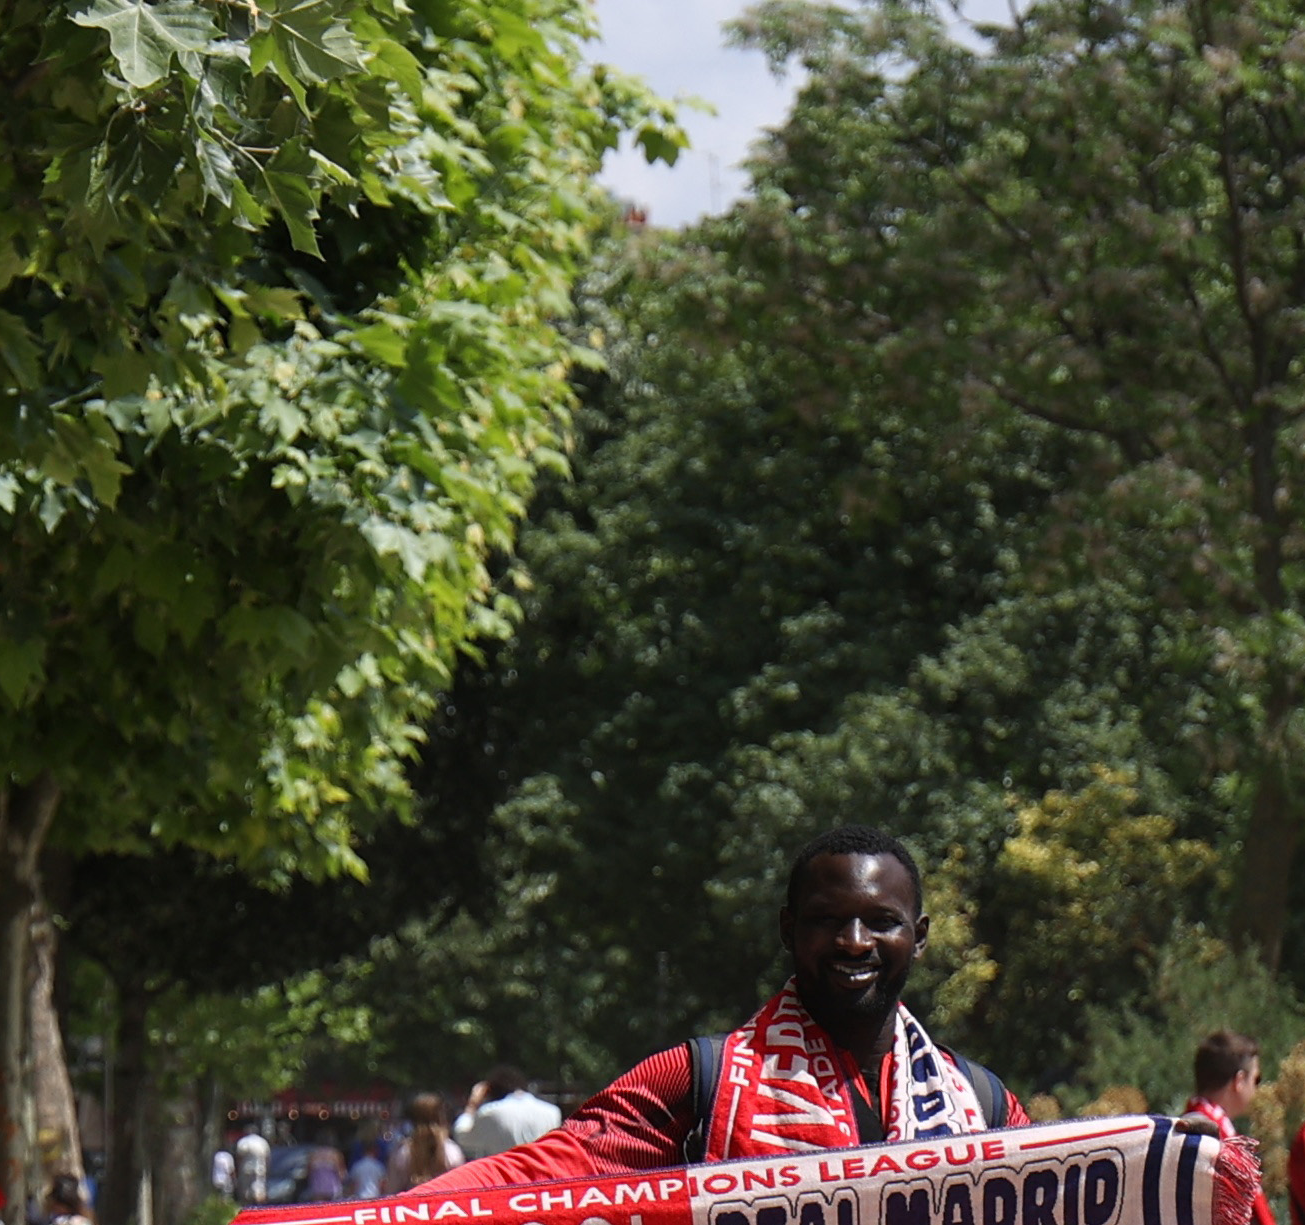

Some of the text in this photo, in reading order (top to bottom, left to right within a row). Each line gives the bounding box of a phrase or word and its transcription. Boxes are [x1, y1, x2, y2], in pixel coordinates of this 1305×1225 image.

[353, 1140, 1007, 1225] FINAL CHAMPIONS LEAGUE
